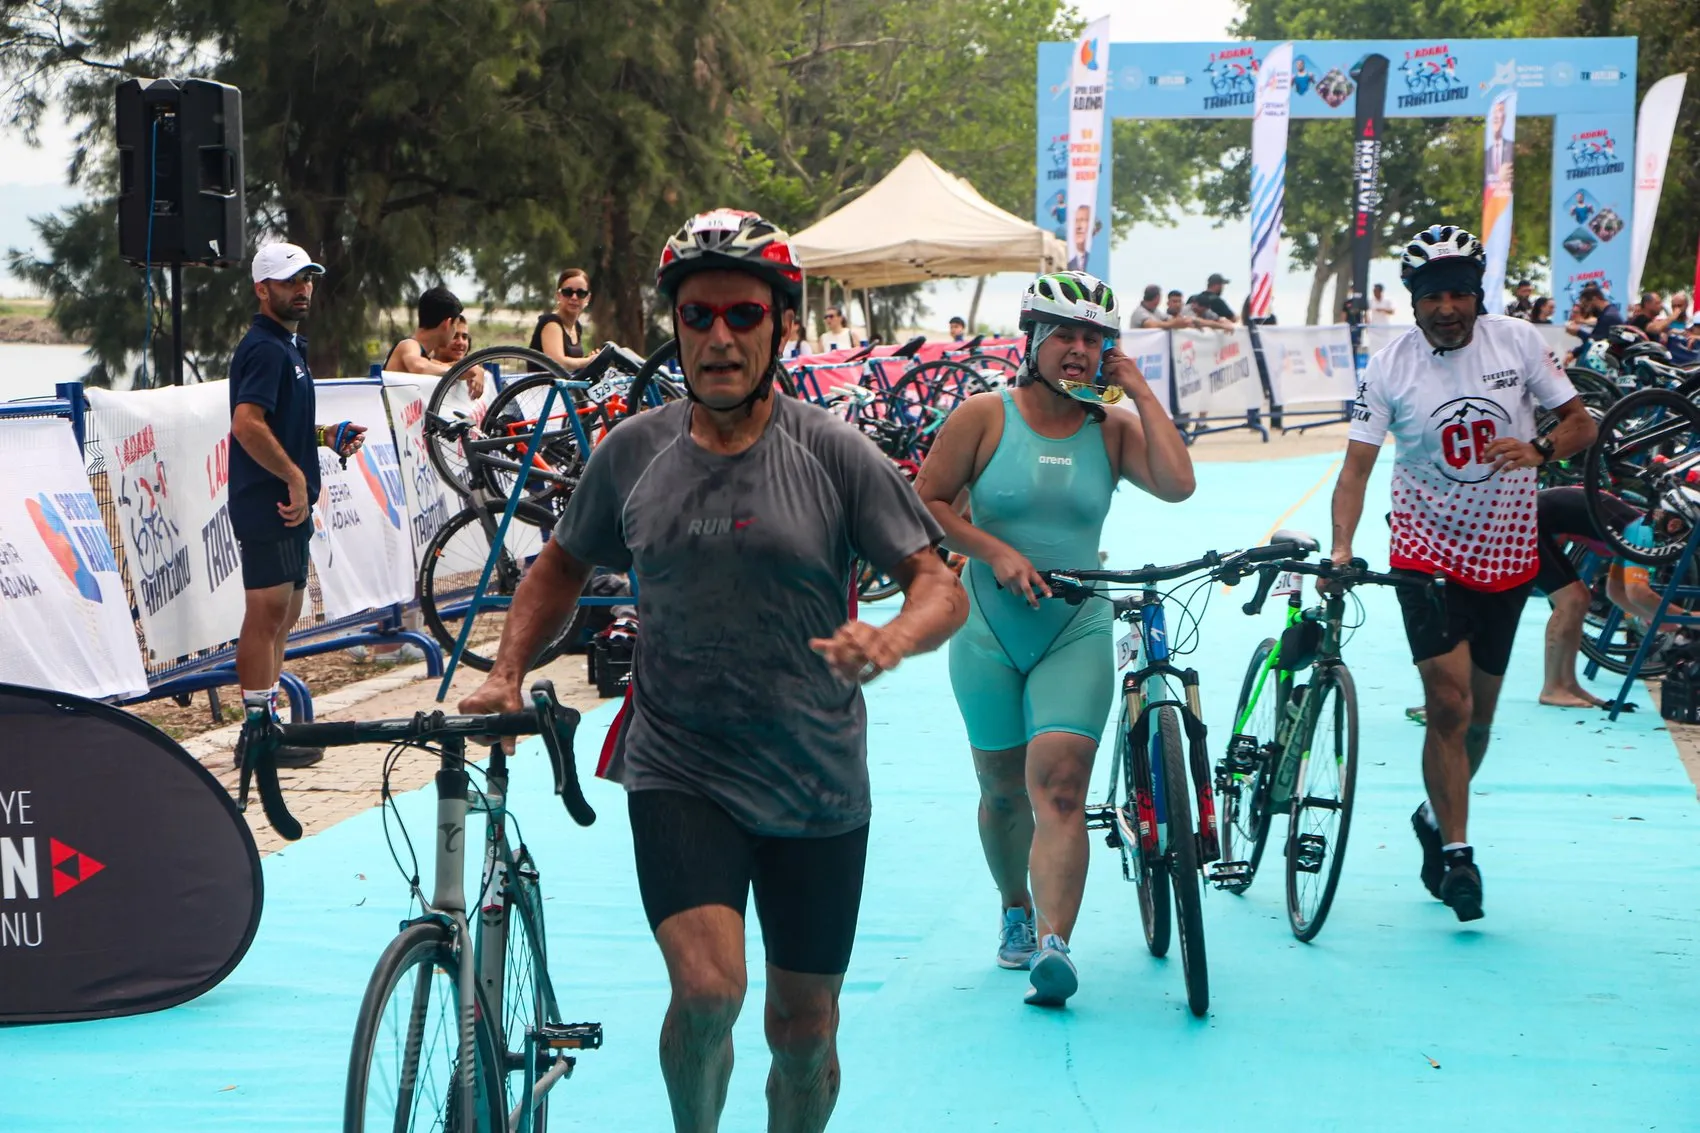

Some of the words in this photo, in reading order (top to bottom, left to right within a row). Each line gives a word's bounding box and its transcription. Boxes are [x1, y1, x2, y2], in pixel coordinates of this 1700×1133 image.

[1085, 309, 1098, 320] 317
[593, 382, 611, 399] 329
[1038, 455, 1073, 466] arena
[687, 517, 732, 536] RUN
